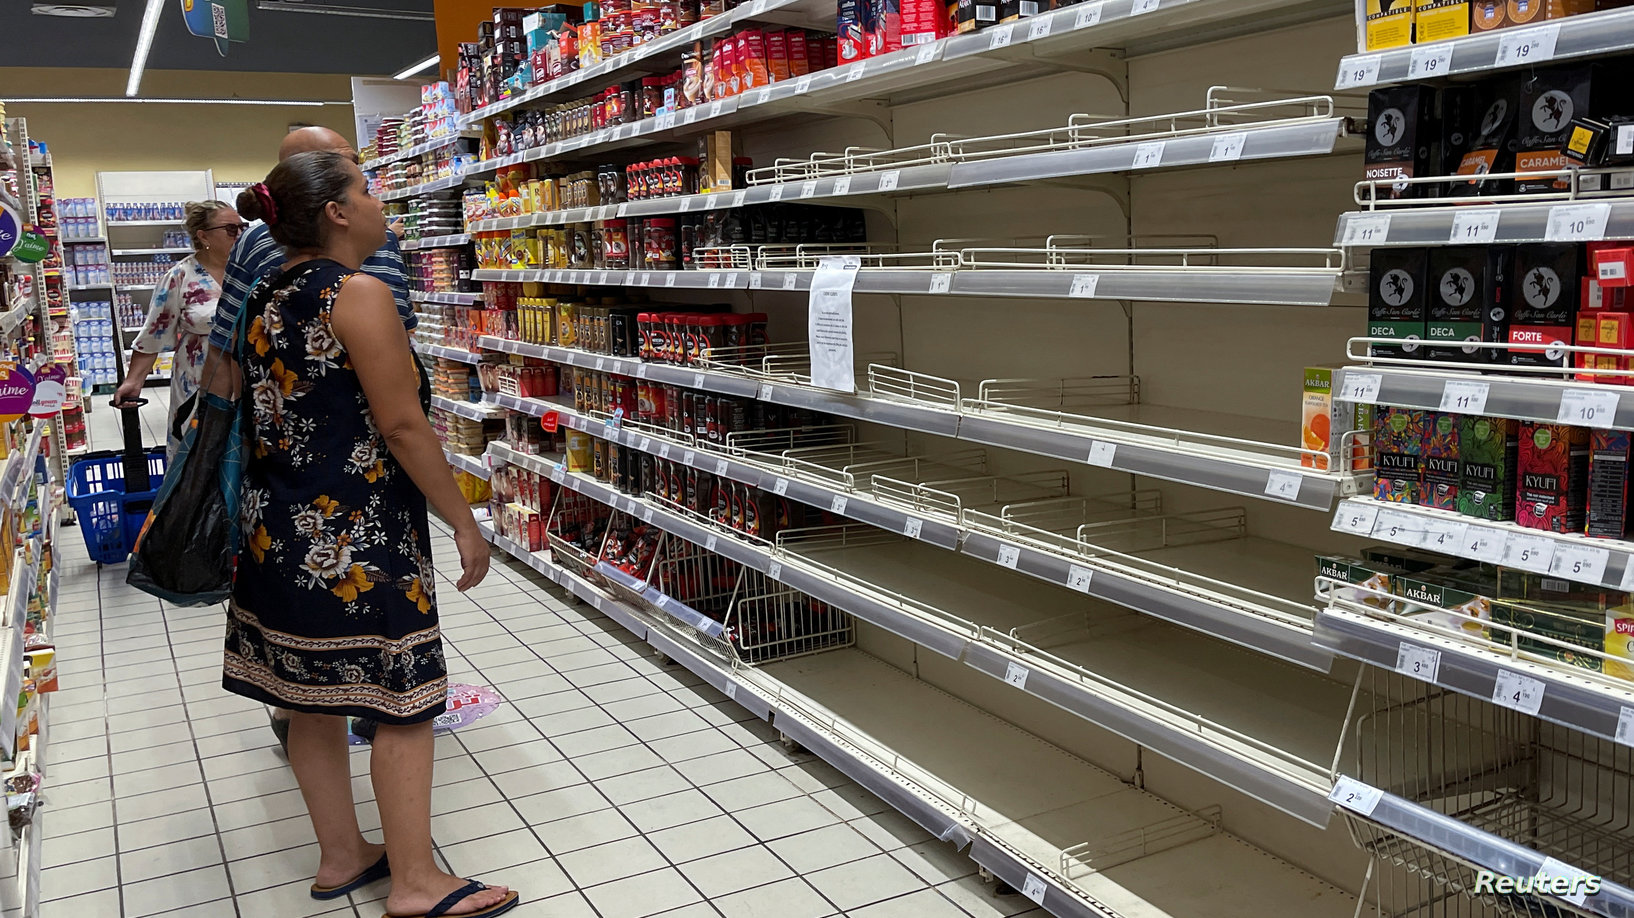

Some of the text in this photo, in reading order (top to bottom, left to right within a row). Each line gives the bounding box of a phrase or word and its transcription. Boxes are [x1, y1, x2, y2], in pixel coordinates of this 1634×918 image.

[1368, 7, 1408, 20] COMPATIBLE
[1516, 45, 1529, 58] 19
[1424, 59, 1437, 72] 19
[1353, 69, 1365, 81] 19
[1366, 167, 1403, 179] NOISETTE
[1466, 225, 1479, 237] 11
[1569, 220, 1585, 234] 10
[1362, 229, 1373, 240] 11
[1371, 327, 1395, 336] DECA
[1430, 327, 1455, 337] DECA
[1512, 331, 1542, 342] FORTE
[1305, 379, 1330, 388] AKBAR
[1354, 387, 1365, 398] 11
[1457, 396, 1469, 409] 11
[1579, 407, 1595, 420] 10
[1351, 516, 1358, 527] 5
[1390, 526, 1397, 537] 5
[1437, 533, 1445, 545] 4
[1470, 541, 1478, 552] 4
[1521, 550, 1529, 561] 5
[1321, 566, 1348, 580] AKBAR
[1573, 561, 1581, 573] 5
[1406, 587, 1441, 604] AKBAR
[1413, 661, 1420, 673] 3
[1513, 690, 1520, 703] 4
[1346, 793, 1355, 803] 2
